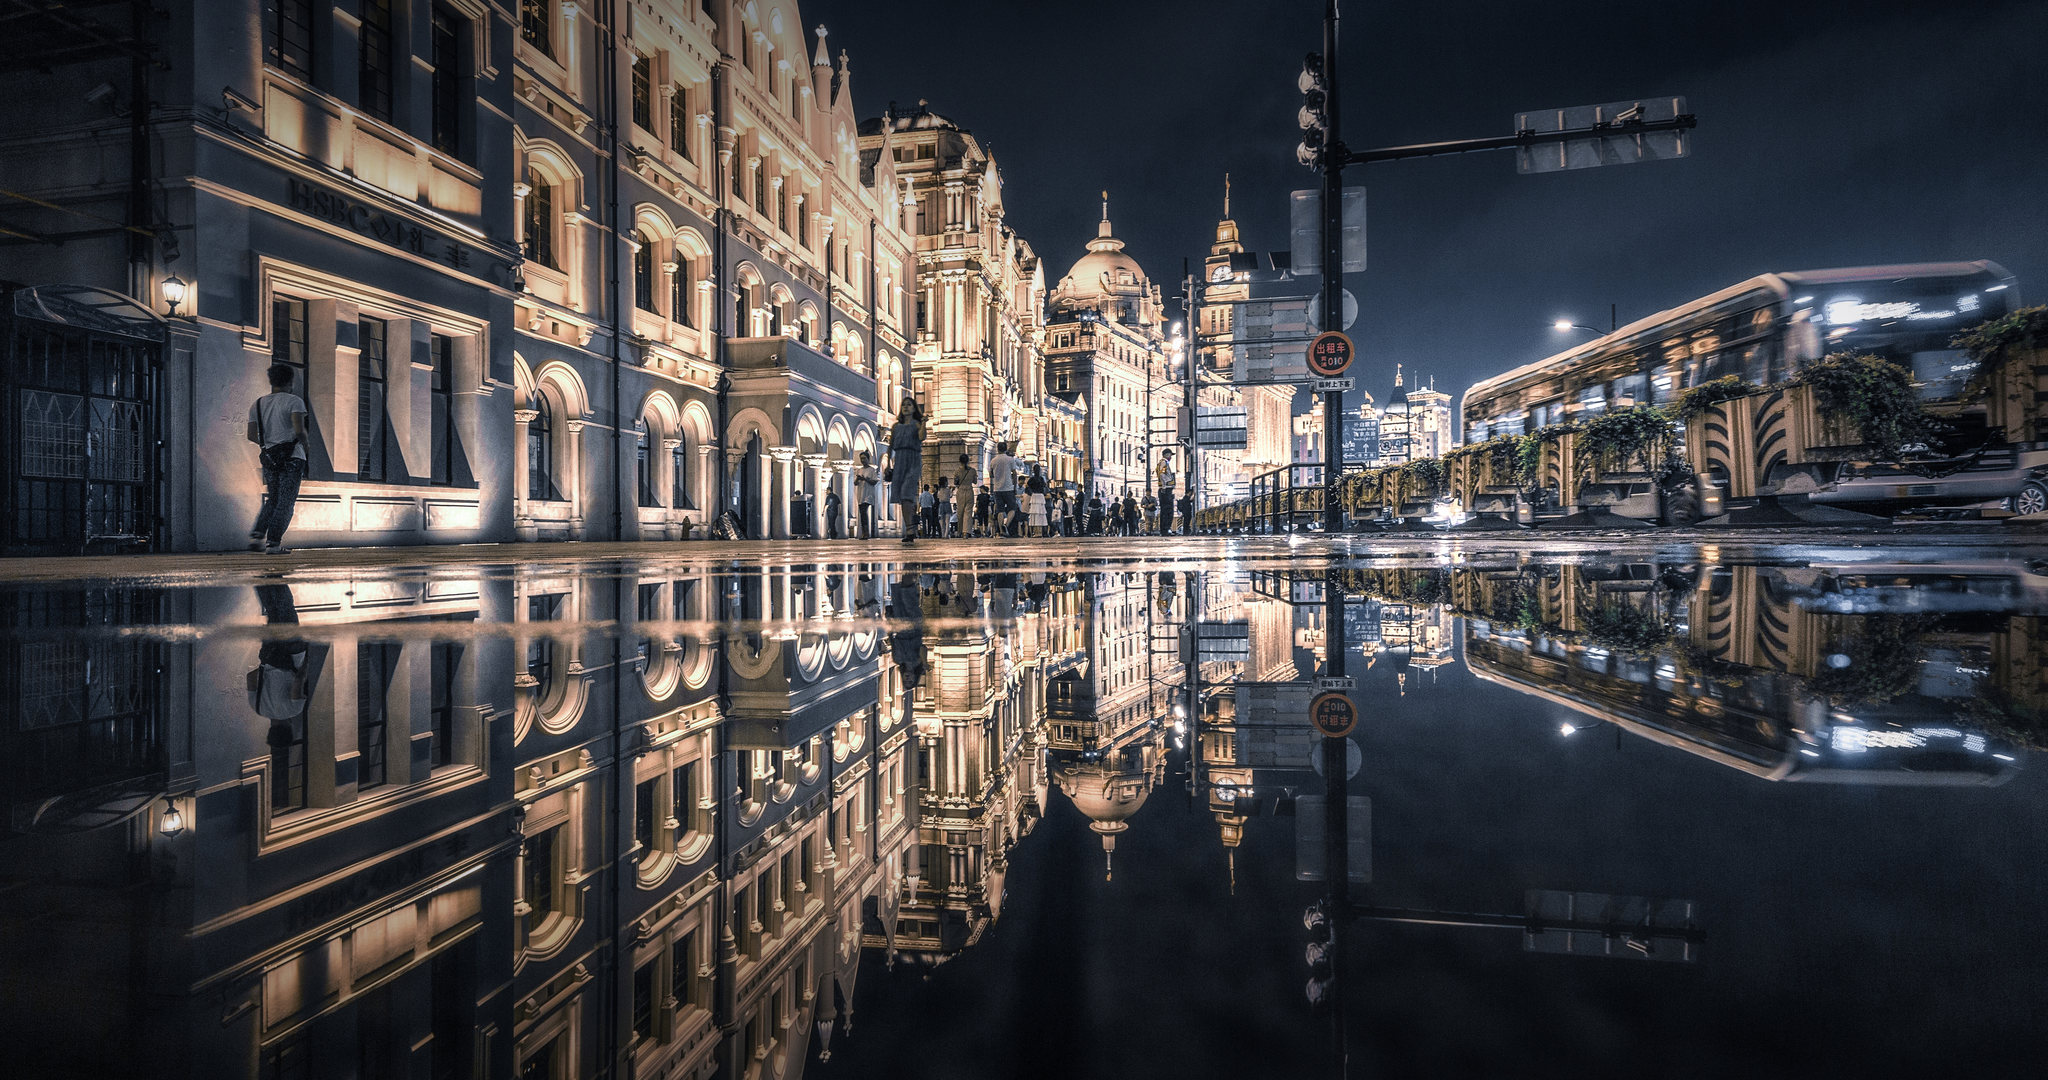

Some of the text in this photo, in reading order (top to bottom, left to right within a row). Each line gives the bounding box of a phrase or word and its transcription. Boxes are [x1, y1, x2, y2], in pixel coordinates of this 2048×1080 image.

[288, 176, 369, 232] HSBC
[410, 227, 471, 269] 汇丰
[1317, 342, 1346, 354] 出租车
[1328, 356, 1344, 366] 010
